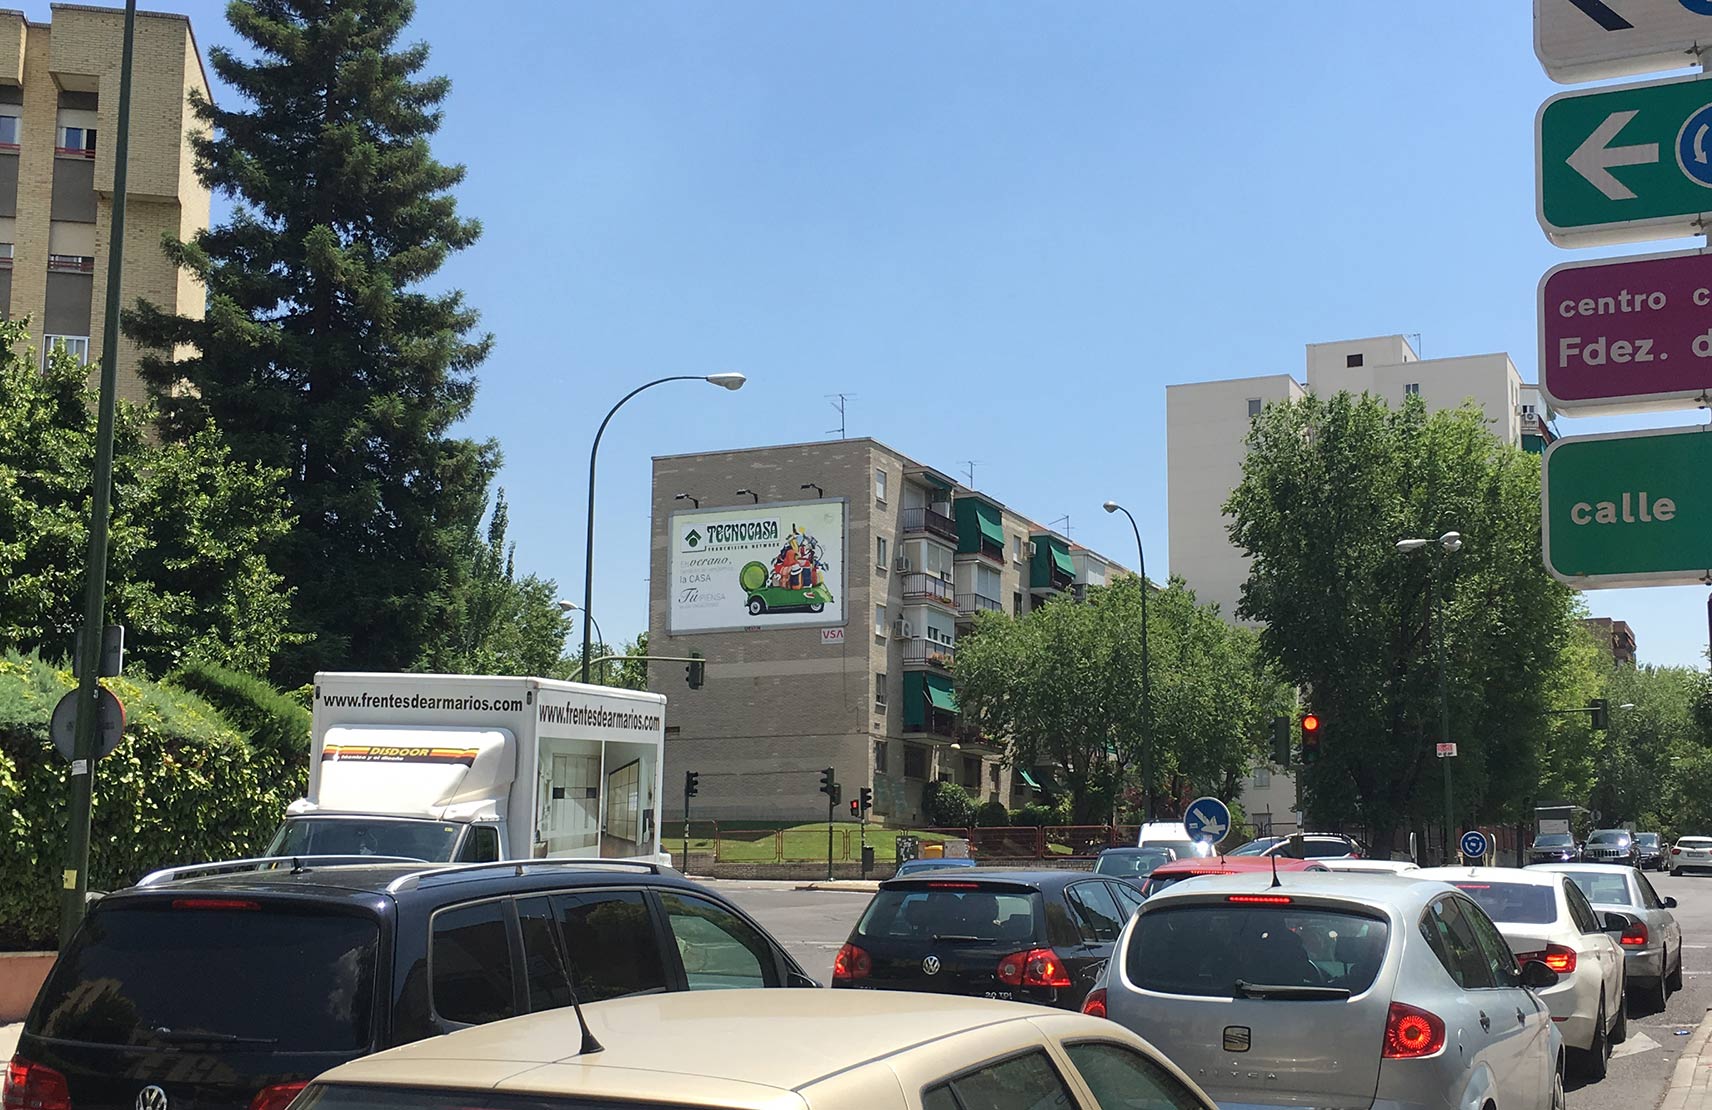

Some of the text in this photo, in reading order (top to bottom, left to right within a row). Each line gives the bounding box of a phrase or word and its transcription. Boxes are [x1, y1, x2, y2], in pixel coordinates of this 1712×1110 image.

[1559, 289, 1667, 318] centro
[1559, 336, 1669, 368] Fdez.
[1570, 491, 1676, 526] calle
[706, 521, 778, 543] TECNOCASA
[323, 692, 523, 712] www.frentesdearmarios.com
[539, 701, 660, 732] www.frentesdearmarios.com
[369, 748, 430, 757] DISDOOR
